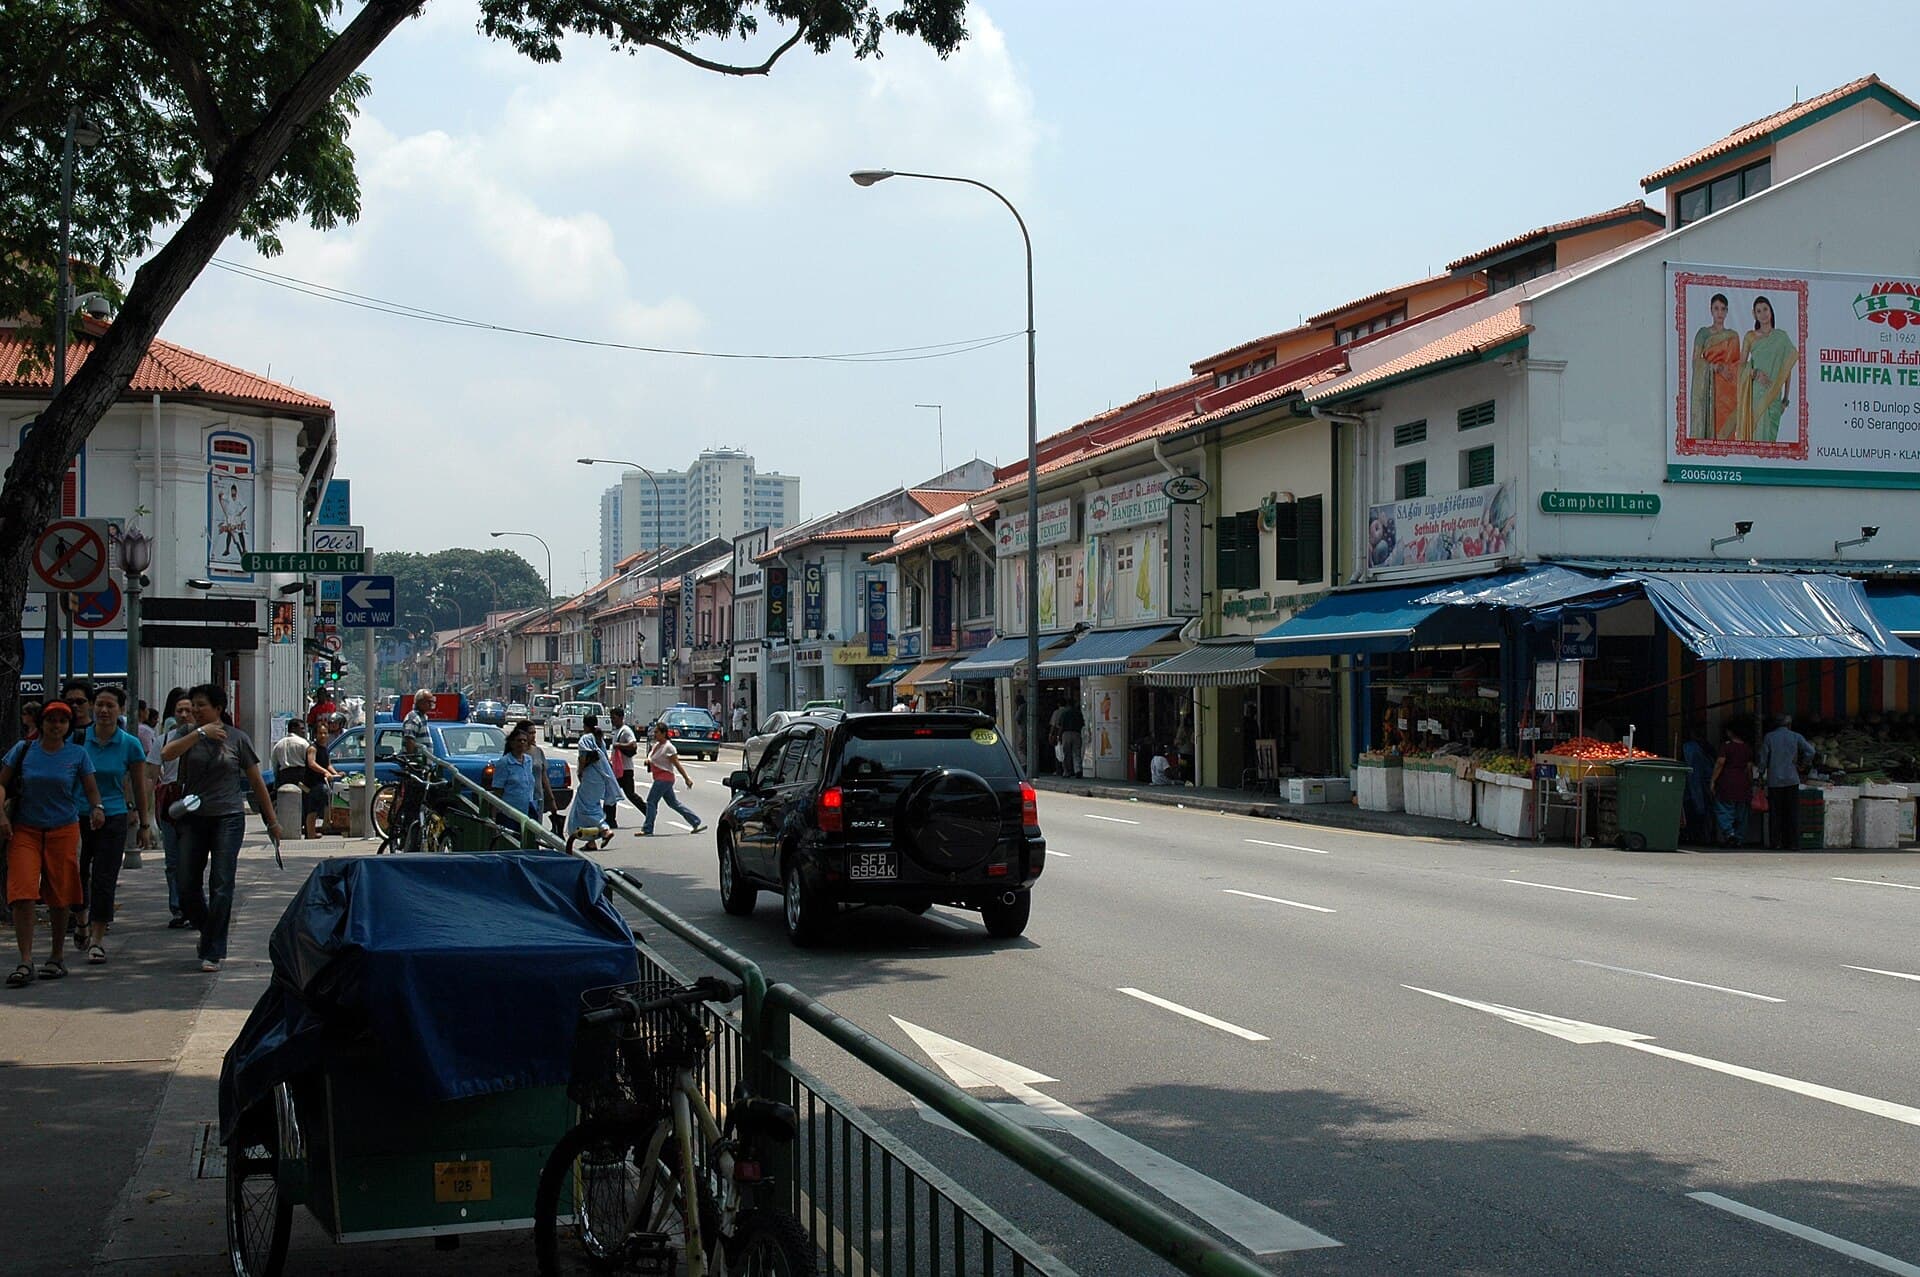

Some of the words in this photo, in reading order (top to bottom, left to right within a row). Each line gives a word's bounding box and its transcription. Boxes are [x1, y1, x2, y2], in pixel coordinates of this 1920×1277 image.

[1895, 333, 1917, 344] 1962
[1820, 365, 1892, 385] HANIFFA
[1897, 368, 1920, 387] TE
[1851, 400, 1870, 412] 118
[1873, 401, 1910, 416] Dunlop
[1850, 417, 1864, 429] 60
[1867, 418, 1920, 434] Serangoo
[1816, 447, 1848, 458] KUALA
[1850, 448, 1891, 460] LUMPUR
[1680, 469, 1742, 482] 2005/03725
[1144, 496, 1169, 514] TEXTIL
[1548, 494, 1615, 510] Campbell
[1620, 496, 1654, 510] Lane
[315, 534, 353, 550] Oli's
[251, 555, 328, 571] Buffalo
[337, 555, 359, 571] Rd
[806, 567, 821, 606] GMT
[345, 611, 367, 624] ONE
[371, 611, 391, 623] WAY
[1562, 644, 1577, 654] ONE
[860, 853, 887, 865] SFB
[851, 865, 895, 877] 6994K
[454, 1180, 473, 1193] 125
